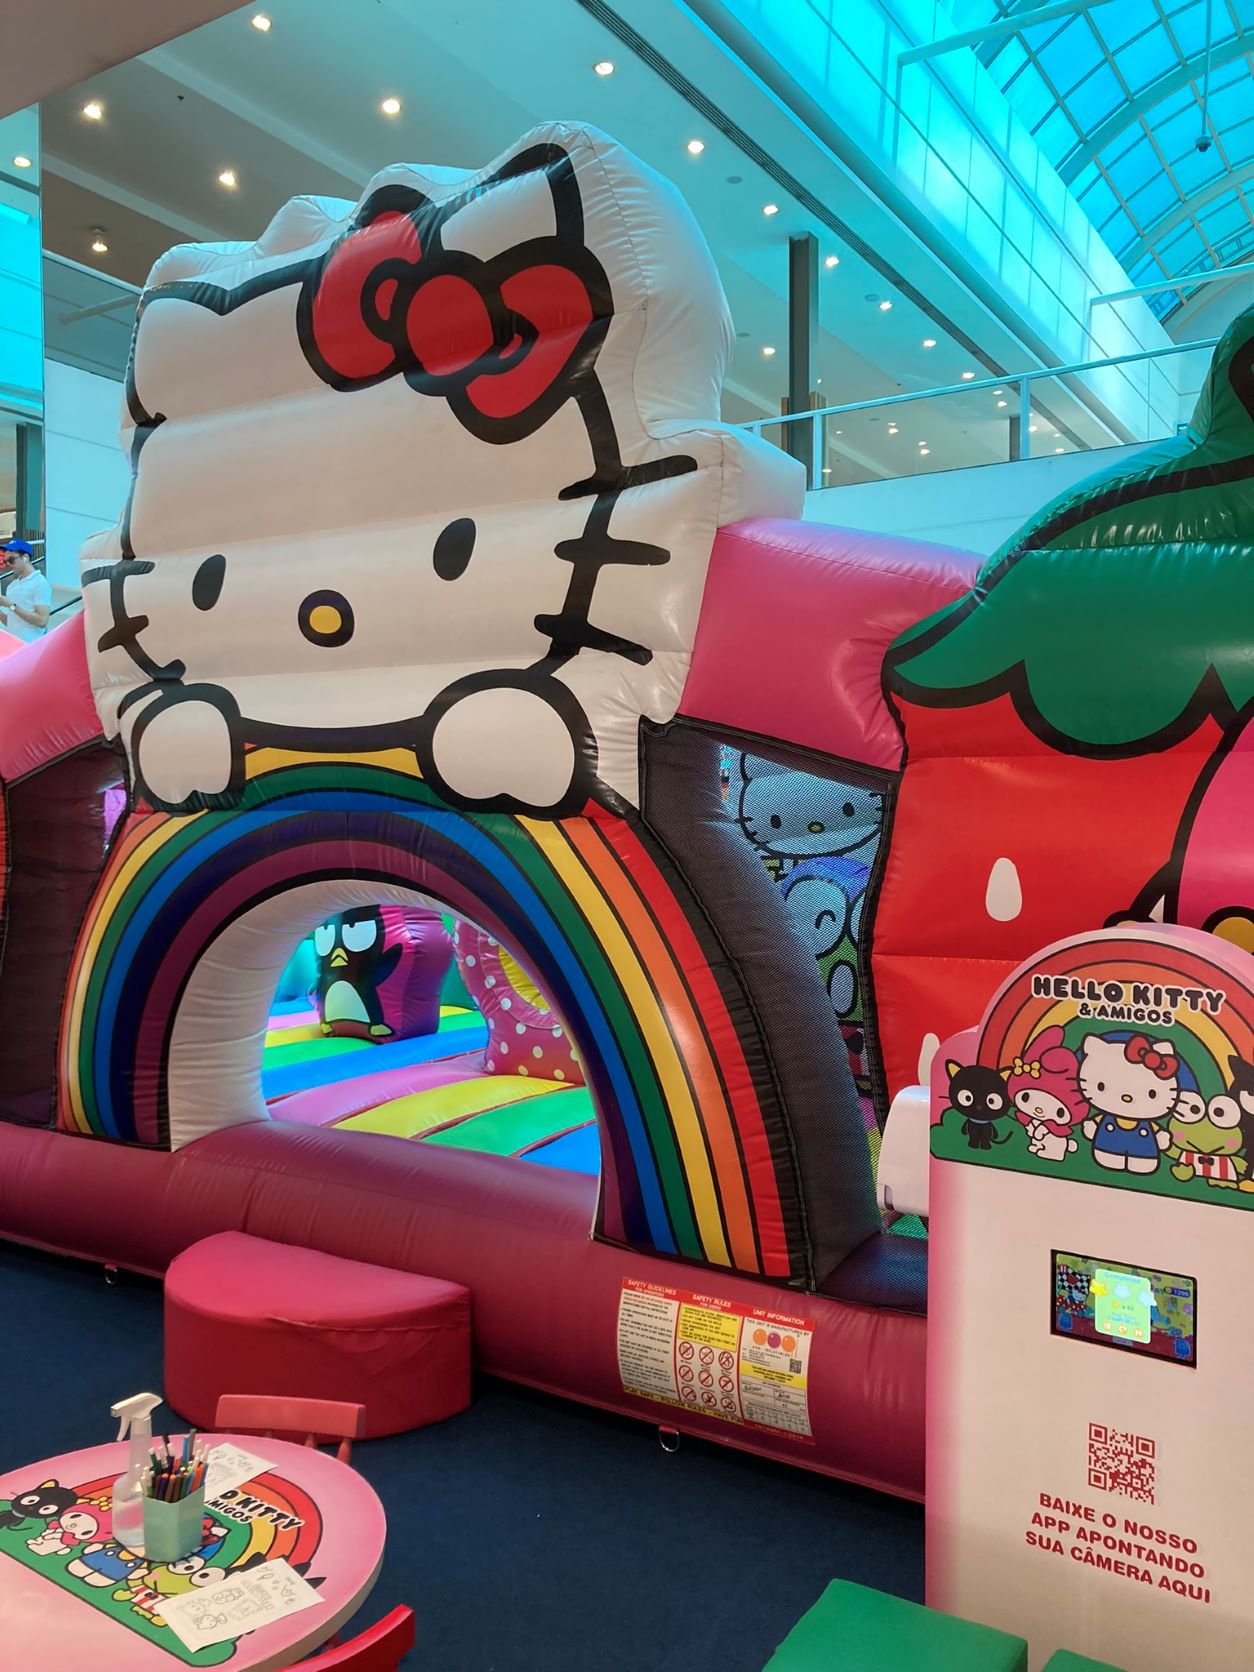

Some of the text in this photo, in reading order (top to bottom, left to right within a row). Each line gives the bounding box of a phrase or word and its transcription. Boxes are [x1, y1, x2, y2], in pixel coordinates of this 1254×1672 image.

[1033, 975, 1224, 1013] HELLO KITTY
[1079, 1002, 1173, 1025] & AMIGOS
[628, 1279, 677, 1296] SAFETY GUIDELINES
[692, 1294, 731, 1308] SAFETY RULES
[753, 1308, 805, 1326] UNIT INFORMATION
[236, 1497, 302, 1530] KITTY
[1039, 1492, 1198, 1554] BAIXE O NOSSO
[1031, 1512, 1205, 1578] APP APONTANDO
[1025, 1531, 1211, 1603] SUA CÂMERA AQUI
